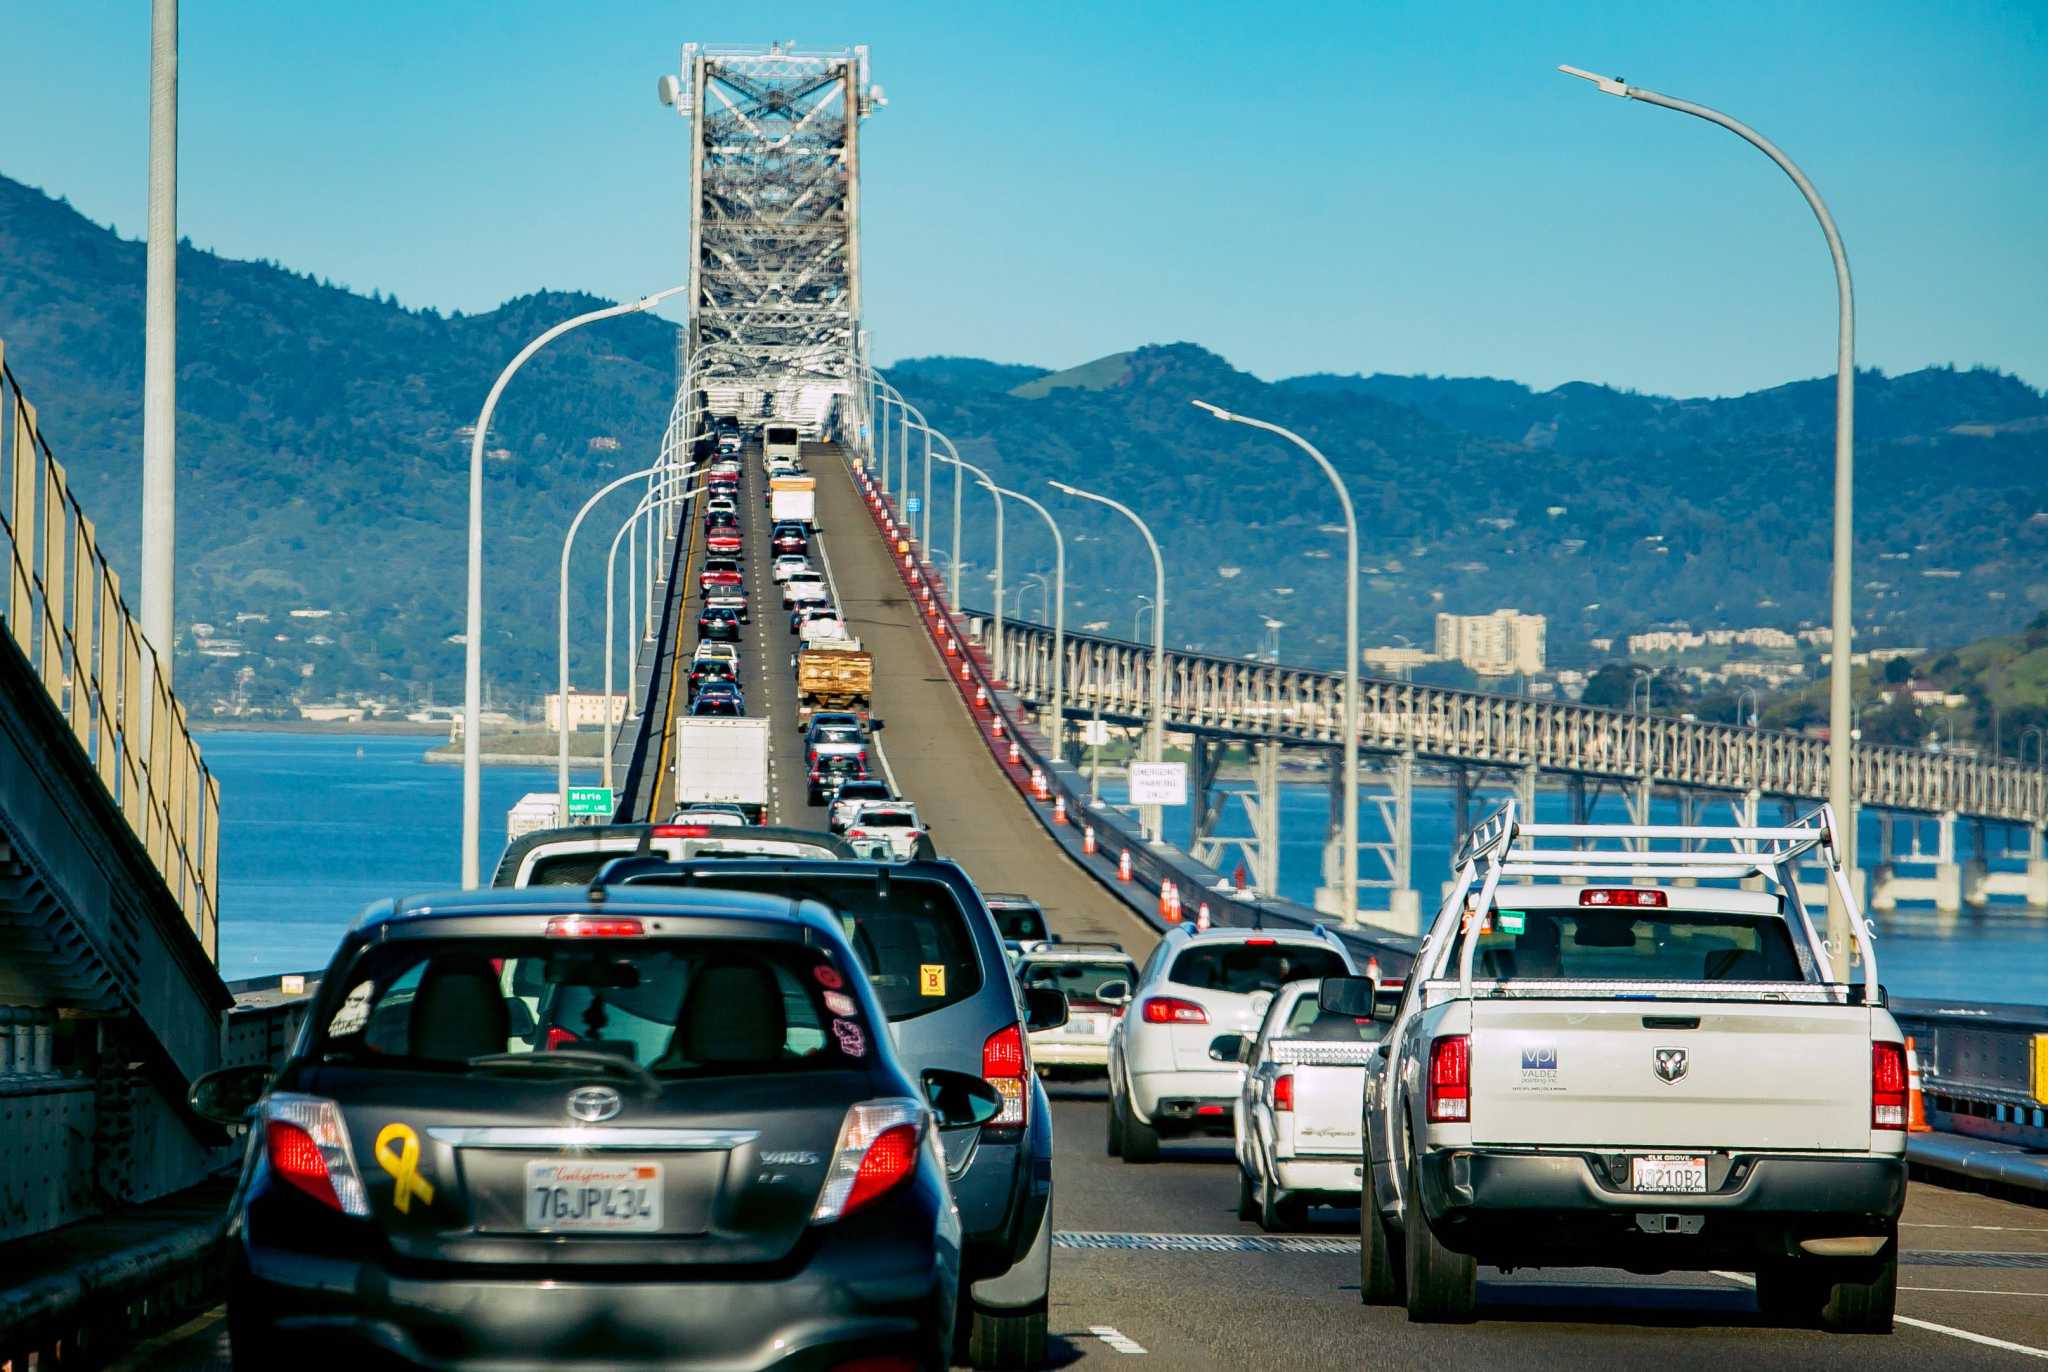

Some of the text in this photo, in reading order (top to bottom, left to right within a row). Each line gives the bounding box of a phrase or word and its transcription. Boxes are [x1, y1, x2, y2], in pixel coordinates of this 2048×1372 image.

[572, 793, 601, 801] Marin
[1521, 1070, 1558, 1078] VALDEZ
[760, 1151, 817, 1166] YARIS
[536, 1186, 651, 1219] 7GJP434
